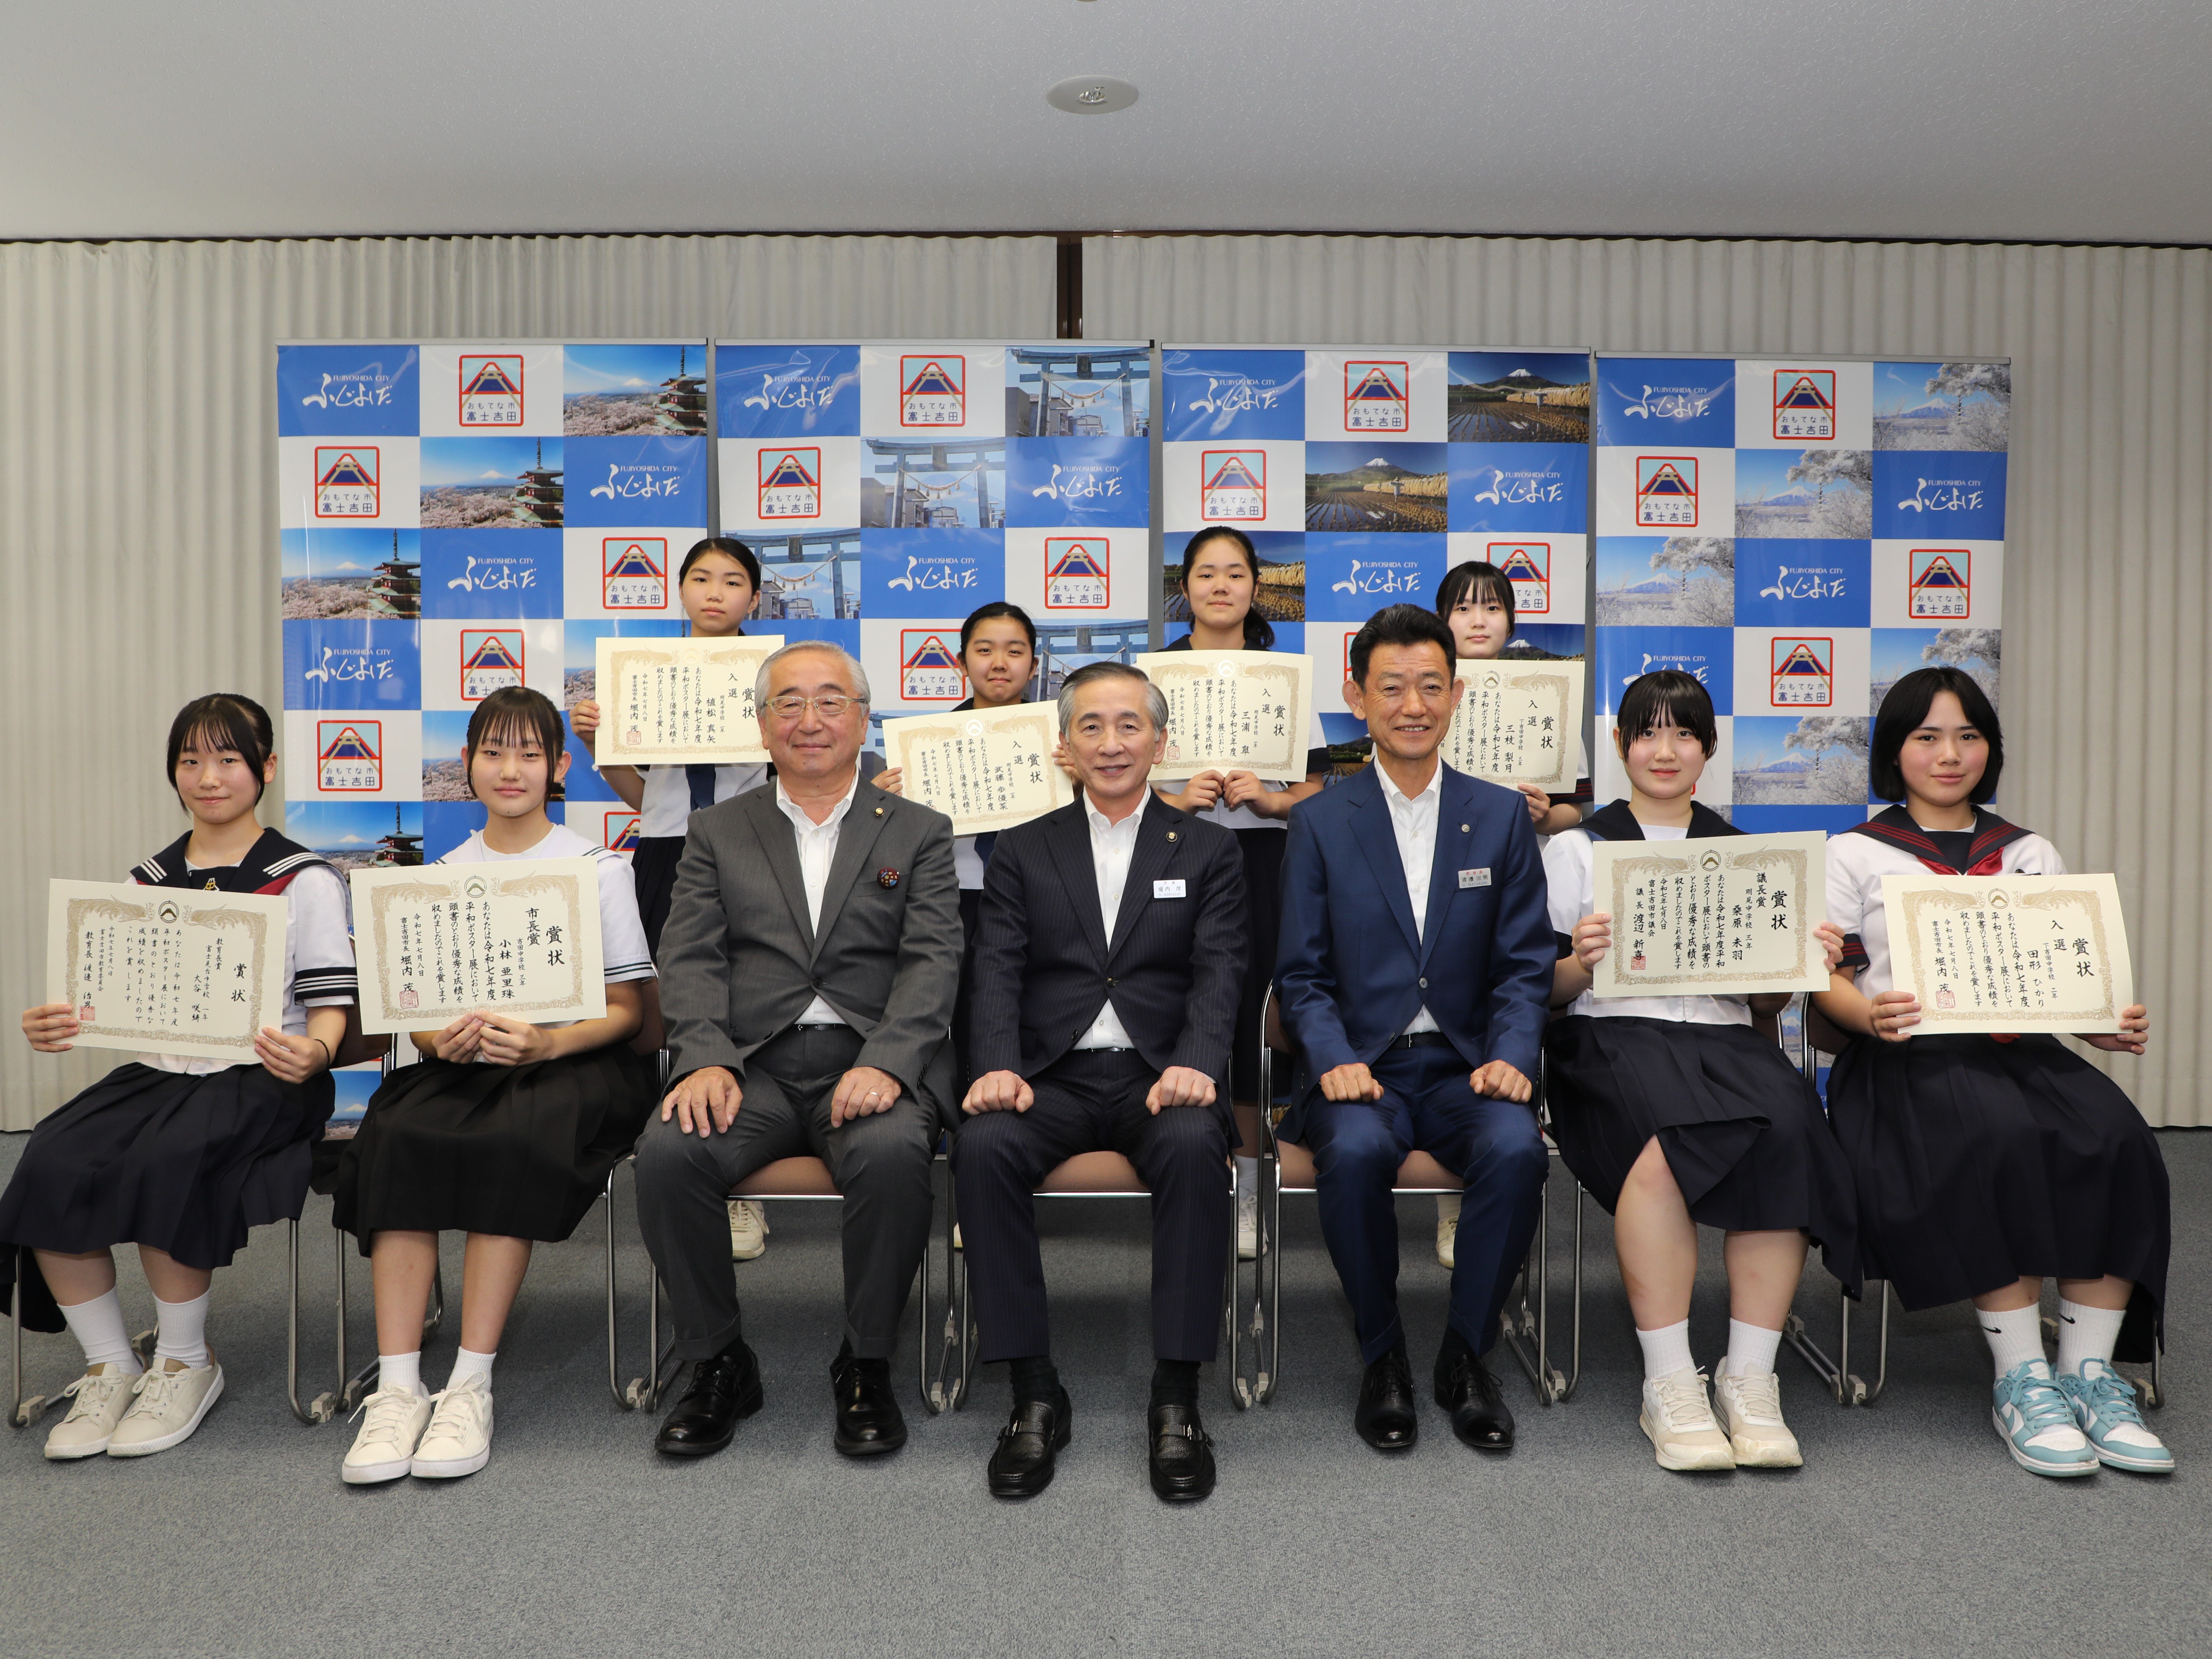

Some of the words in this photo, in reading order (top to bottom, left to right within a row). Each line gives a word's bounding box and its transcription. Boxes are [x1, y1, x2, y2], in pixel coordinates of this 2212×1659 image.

[467, 412, 516, 421] 富士吉田
[908, 412, 958, 421] 富士吉田
[1352, 417, 1402, 427] 富士吉田
[1781, 425, 1828, 435] 富士吉田
[323, 503, 372, 513] 富士吉田
[766, 504, 813, 513] 富士吉田
[1209, 506, 1259, 515] 富士吉田
[1643, 512, 1691, 522] 富士吉田
[610, 594, 660, 604] 富士吉田
[1052, 594, 1102, 604] 富士吉田
[1917, 604, 1963, 614] 富士吉田
[728, 673, 738, 698] 入選
[908, 685, 958, 695] 富士吉田
[1778, 692, 1825, 702] 富士吉田
[706, 698, 716, 717] 植松
[742, 688, 755, 719] 賞状
[1262, 688, 1271, 714] 入選
[1527, 700, 1538, 726] 入選
[1242, 711, 1250, 732] 三浦
[1274, 705, 1286, 736] 賞状
[1541, 716, 1554, 749] 賞状
[707, 724, 716, 743] 真矢
[1505, 725, 1515, 745] 三枝
[1013, 741, 1024, 764] 入選
[1504, 752, 1514, 773] 梨月
[995, 766, 1004, 781] 武藤
[1028, 753, 1043, 783] 賞状
[325, 777, 375, 786] 富士吉田
[1756, 872, 1767, 908] 議長賞
[1634, 914, 1644, 932] 渡辺
[1674, 877, 1684, 969] 収めましたのでこれを賞します
[1687, 876, 1697, 969] とおり優秀な成績を
[1701, 875, 1711, 968] ポスター展において頭書の
[1715, 874, 1725, 968] あなたは令和七年度平和
[1732, 905, 1742, 928] 桑原
[1771, 891, 1787, 930] 賞状
[401, 917, 410, 952] 富士吉田市長
[525, 908, 540, 946] 市長賞
[1932, 921, 1943, 953] 富士吉田市長
[2051, 920, 2067, 951] 入選
[85, 931, 94, 958] 教育長
[414, 913, 424, 976] 令和七年七月八日
[432, 904, 446, 1004] 収めましたのでこれを賞します
[449, 902, 464, 1003] 頭書のとおり優秀な成績を
[465, 902, 479, 1002] 平和ポスター展において
[483, 901, 496, 1000] あなたは令和七年度
[499, 939, 512, 959] 小林
[517, 938, 525, 970] 吉田中学校
[546, 926, 565, 966] 賞状
[1633, 939, 1644, 961] 新喜
[1732, 937, 1742, 960] 未羽
[1745, 935, 1752, 949] 三年
[1945, 919, 1958, 979] 令和七年七月八日
[401, 955, 412, 976] 堀内
[1935, 957, 1947, 977] 堀内
[1960, 911, 1982, 1007] 収めましたのでこれを賞します
[1991, 912, 2012, 1007] 平和ポスター展において
[2008, 912, 2030, 1007] あなたは令和七年度
[2027, 950, 2041, 970] 田形
[2073, 938, 2094, 977] 賞状
[194, 975, 201, 992] 大谷
[231, 963, 247, 1002] 賞状
[501, 967, 515, 998] 亜里珠
[519, 974, 526, 986] 三年
[2043, 943, 2055, 980] 下吉田中学校
[2051, 988, 2058, 999] 二年
[83, 992, 91, 1008] 治男
[2033, 979, 2044, 1007] ひかり
